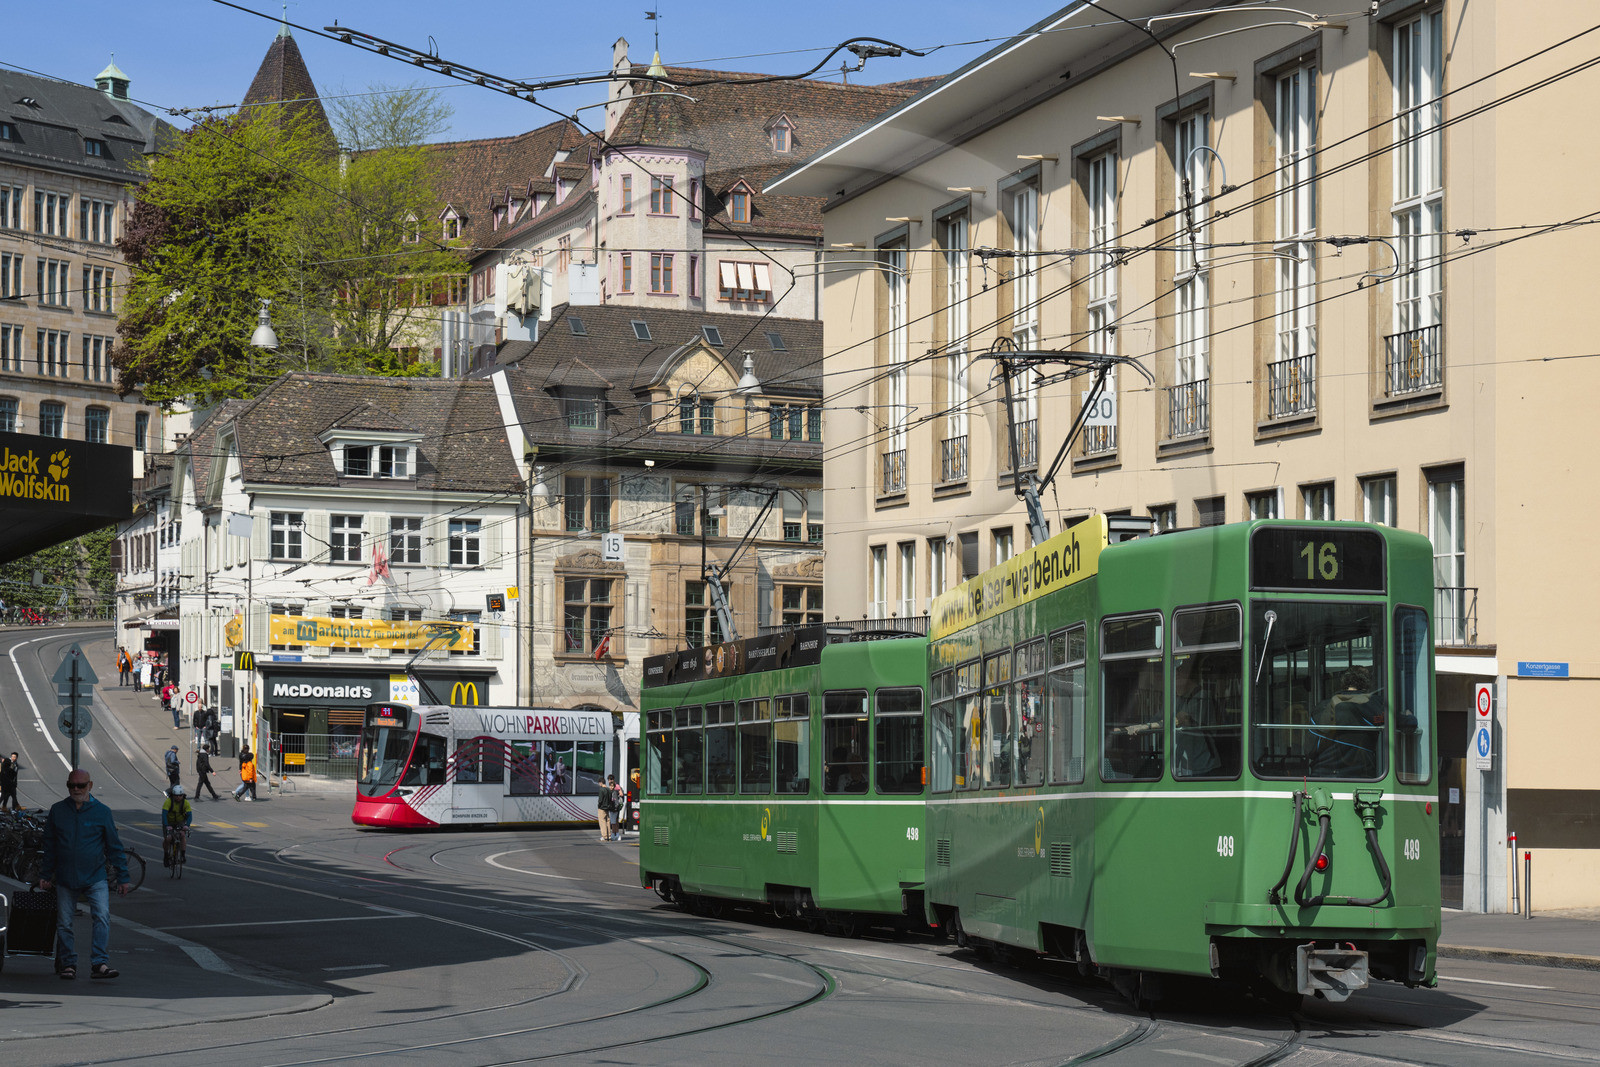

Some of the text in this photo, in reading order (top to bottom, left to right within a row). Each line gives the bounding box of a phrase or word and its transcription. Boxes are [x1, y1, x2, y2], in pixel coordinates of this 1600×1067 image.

[0, 447, 40, 475] Jack
[0, 472, 70, 502] Wolfskin
[606, 538, 621, 553] 15
[1301, 541, 1338, 579] 16
[940, 532, 1081, 632] www.besser-werben.ch
[282, 627, 295, 635] am
[373, 629, 384, 639] für
[386, 630, 406, 640] DICH
[1525, 662, 1561, 671] Konzertgasse
[273, 683, 372, 699] McDonald's
[480, 714, 606, 735] WOHNPARKBINZEN
[906, 827, 919, 841] 498
[1216, 835, 1234, 857] 489
[1404, 838, 1420, 860] 489
